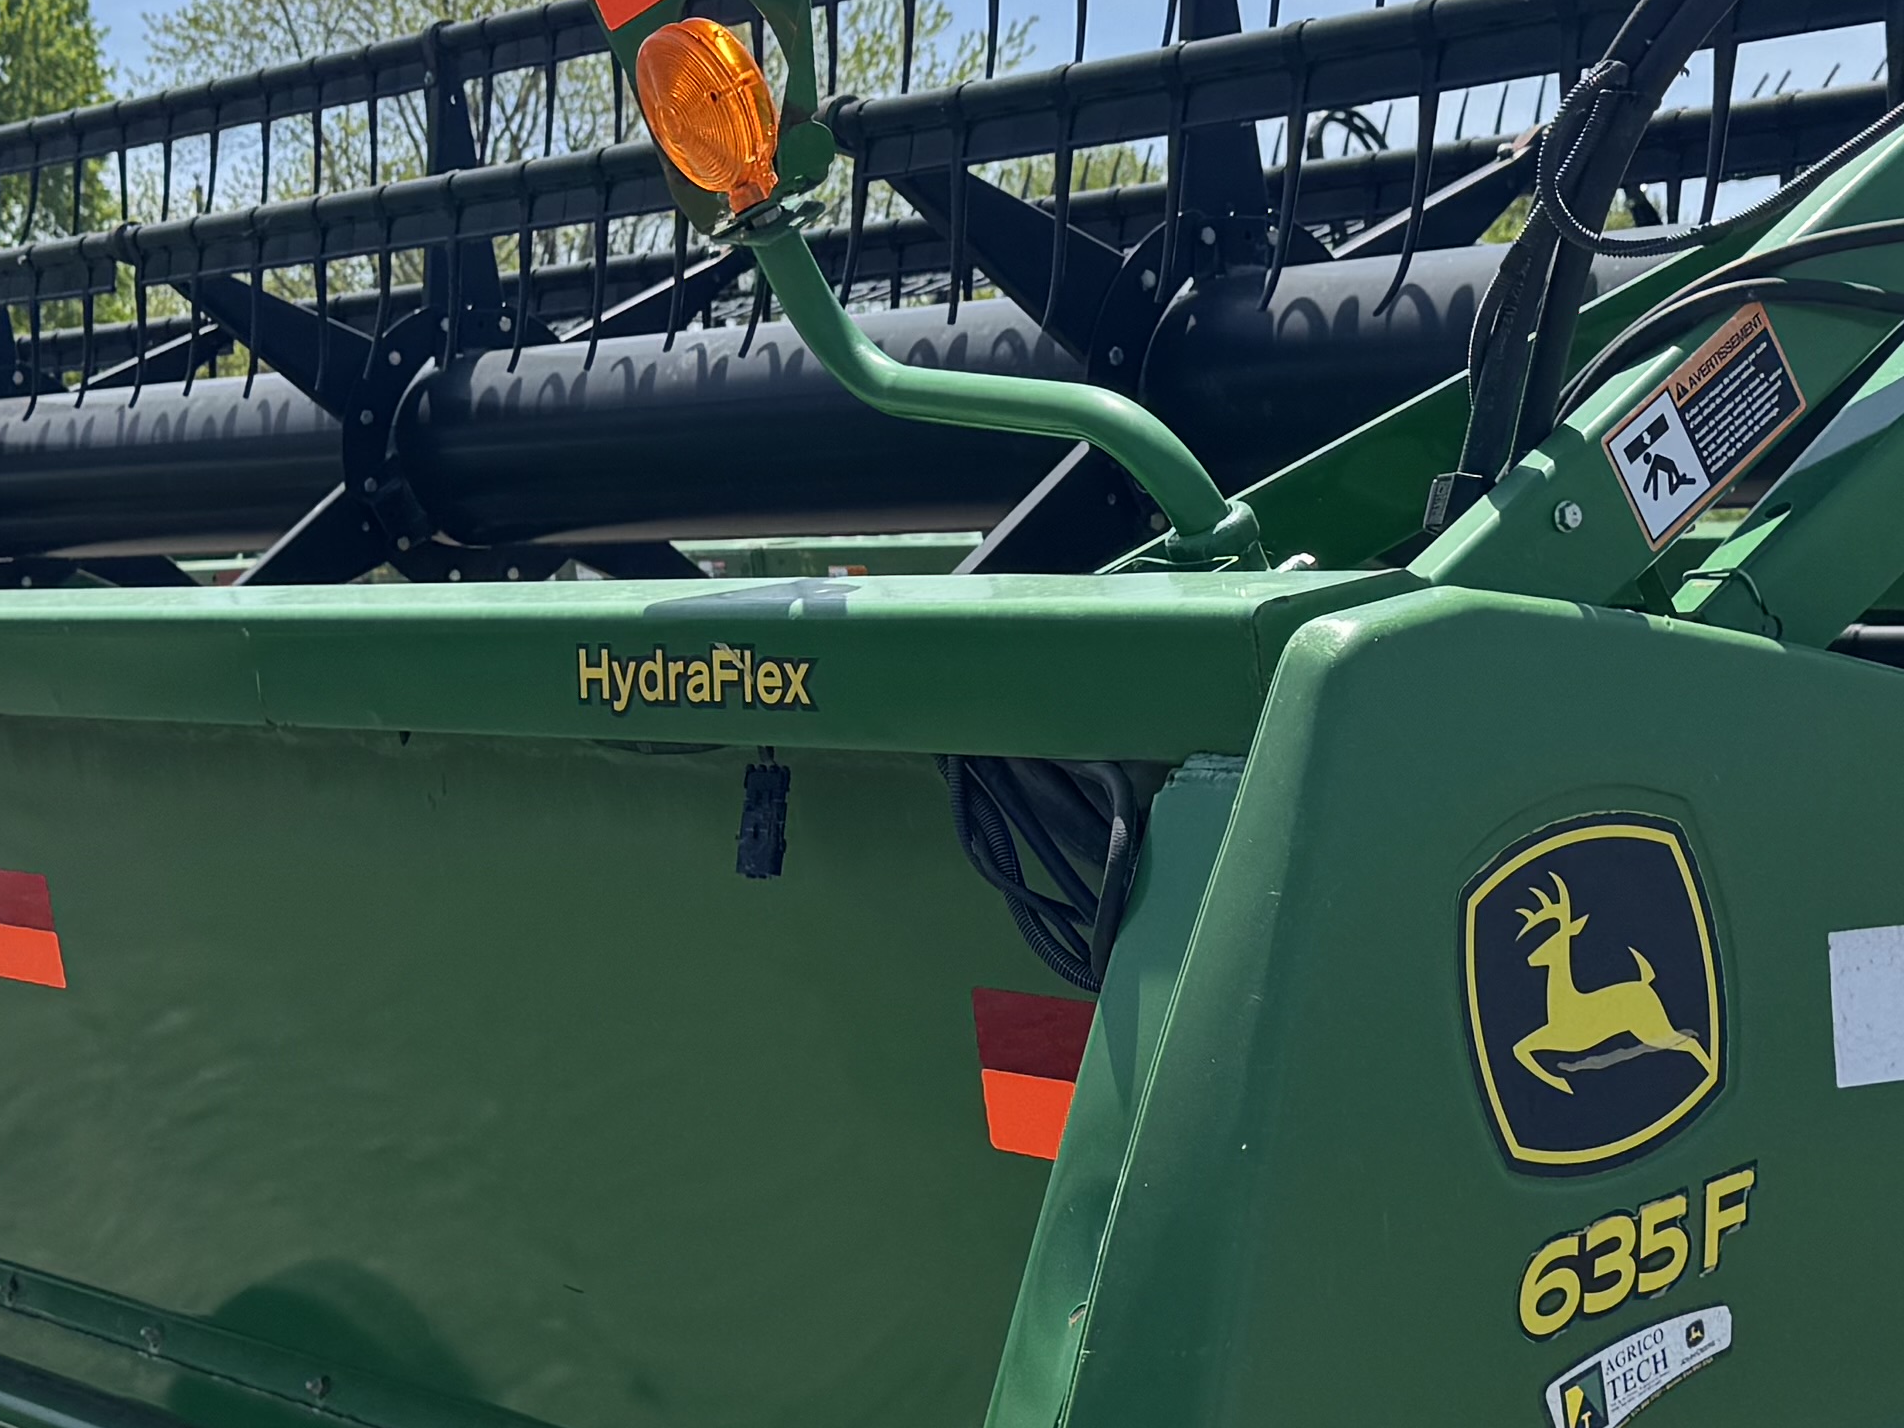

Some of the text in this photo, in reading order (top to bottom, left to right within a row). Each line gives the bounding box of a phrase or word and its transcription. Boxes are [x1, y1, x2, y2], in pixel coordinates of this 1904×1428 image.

[1688, 311, 1763, 390] AVERTISSEMENT
[577, 647, 811, 712] HydraFlex
[1605, 1328, 1664, 1376] AGRICO
[1606, 1348, 1669, 1401] TECH
